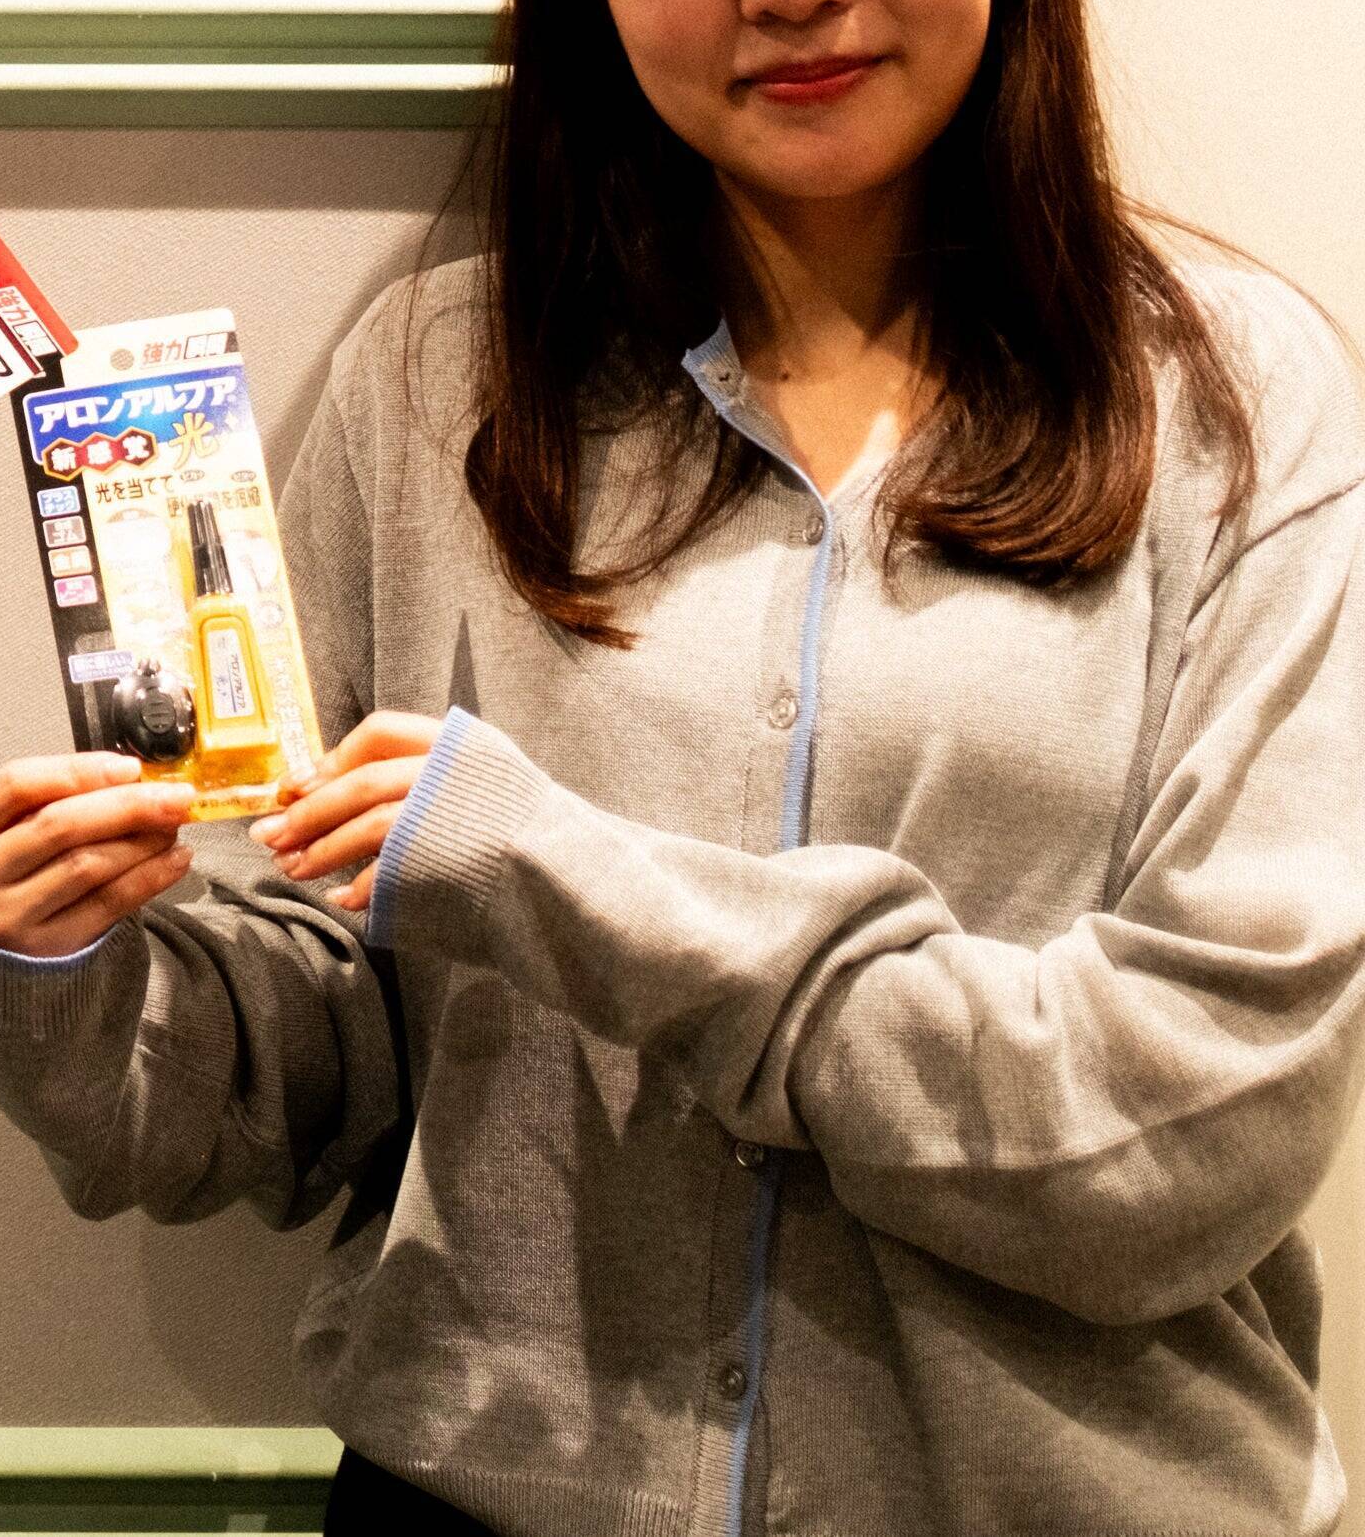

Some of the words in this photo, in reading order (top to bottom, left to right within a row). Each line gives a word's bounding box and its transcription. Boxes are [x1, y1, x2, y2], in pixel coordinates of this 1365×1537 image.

[167, 413, 219, 470] 光
[94, 474, 175, 504] 光を当てて
